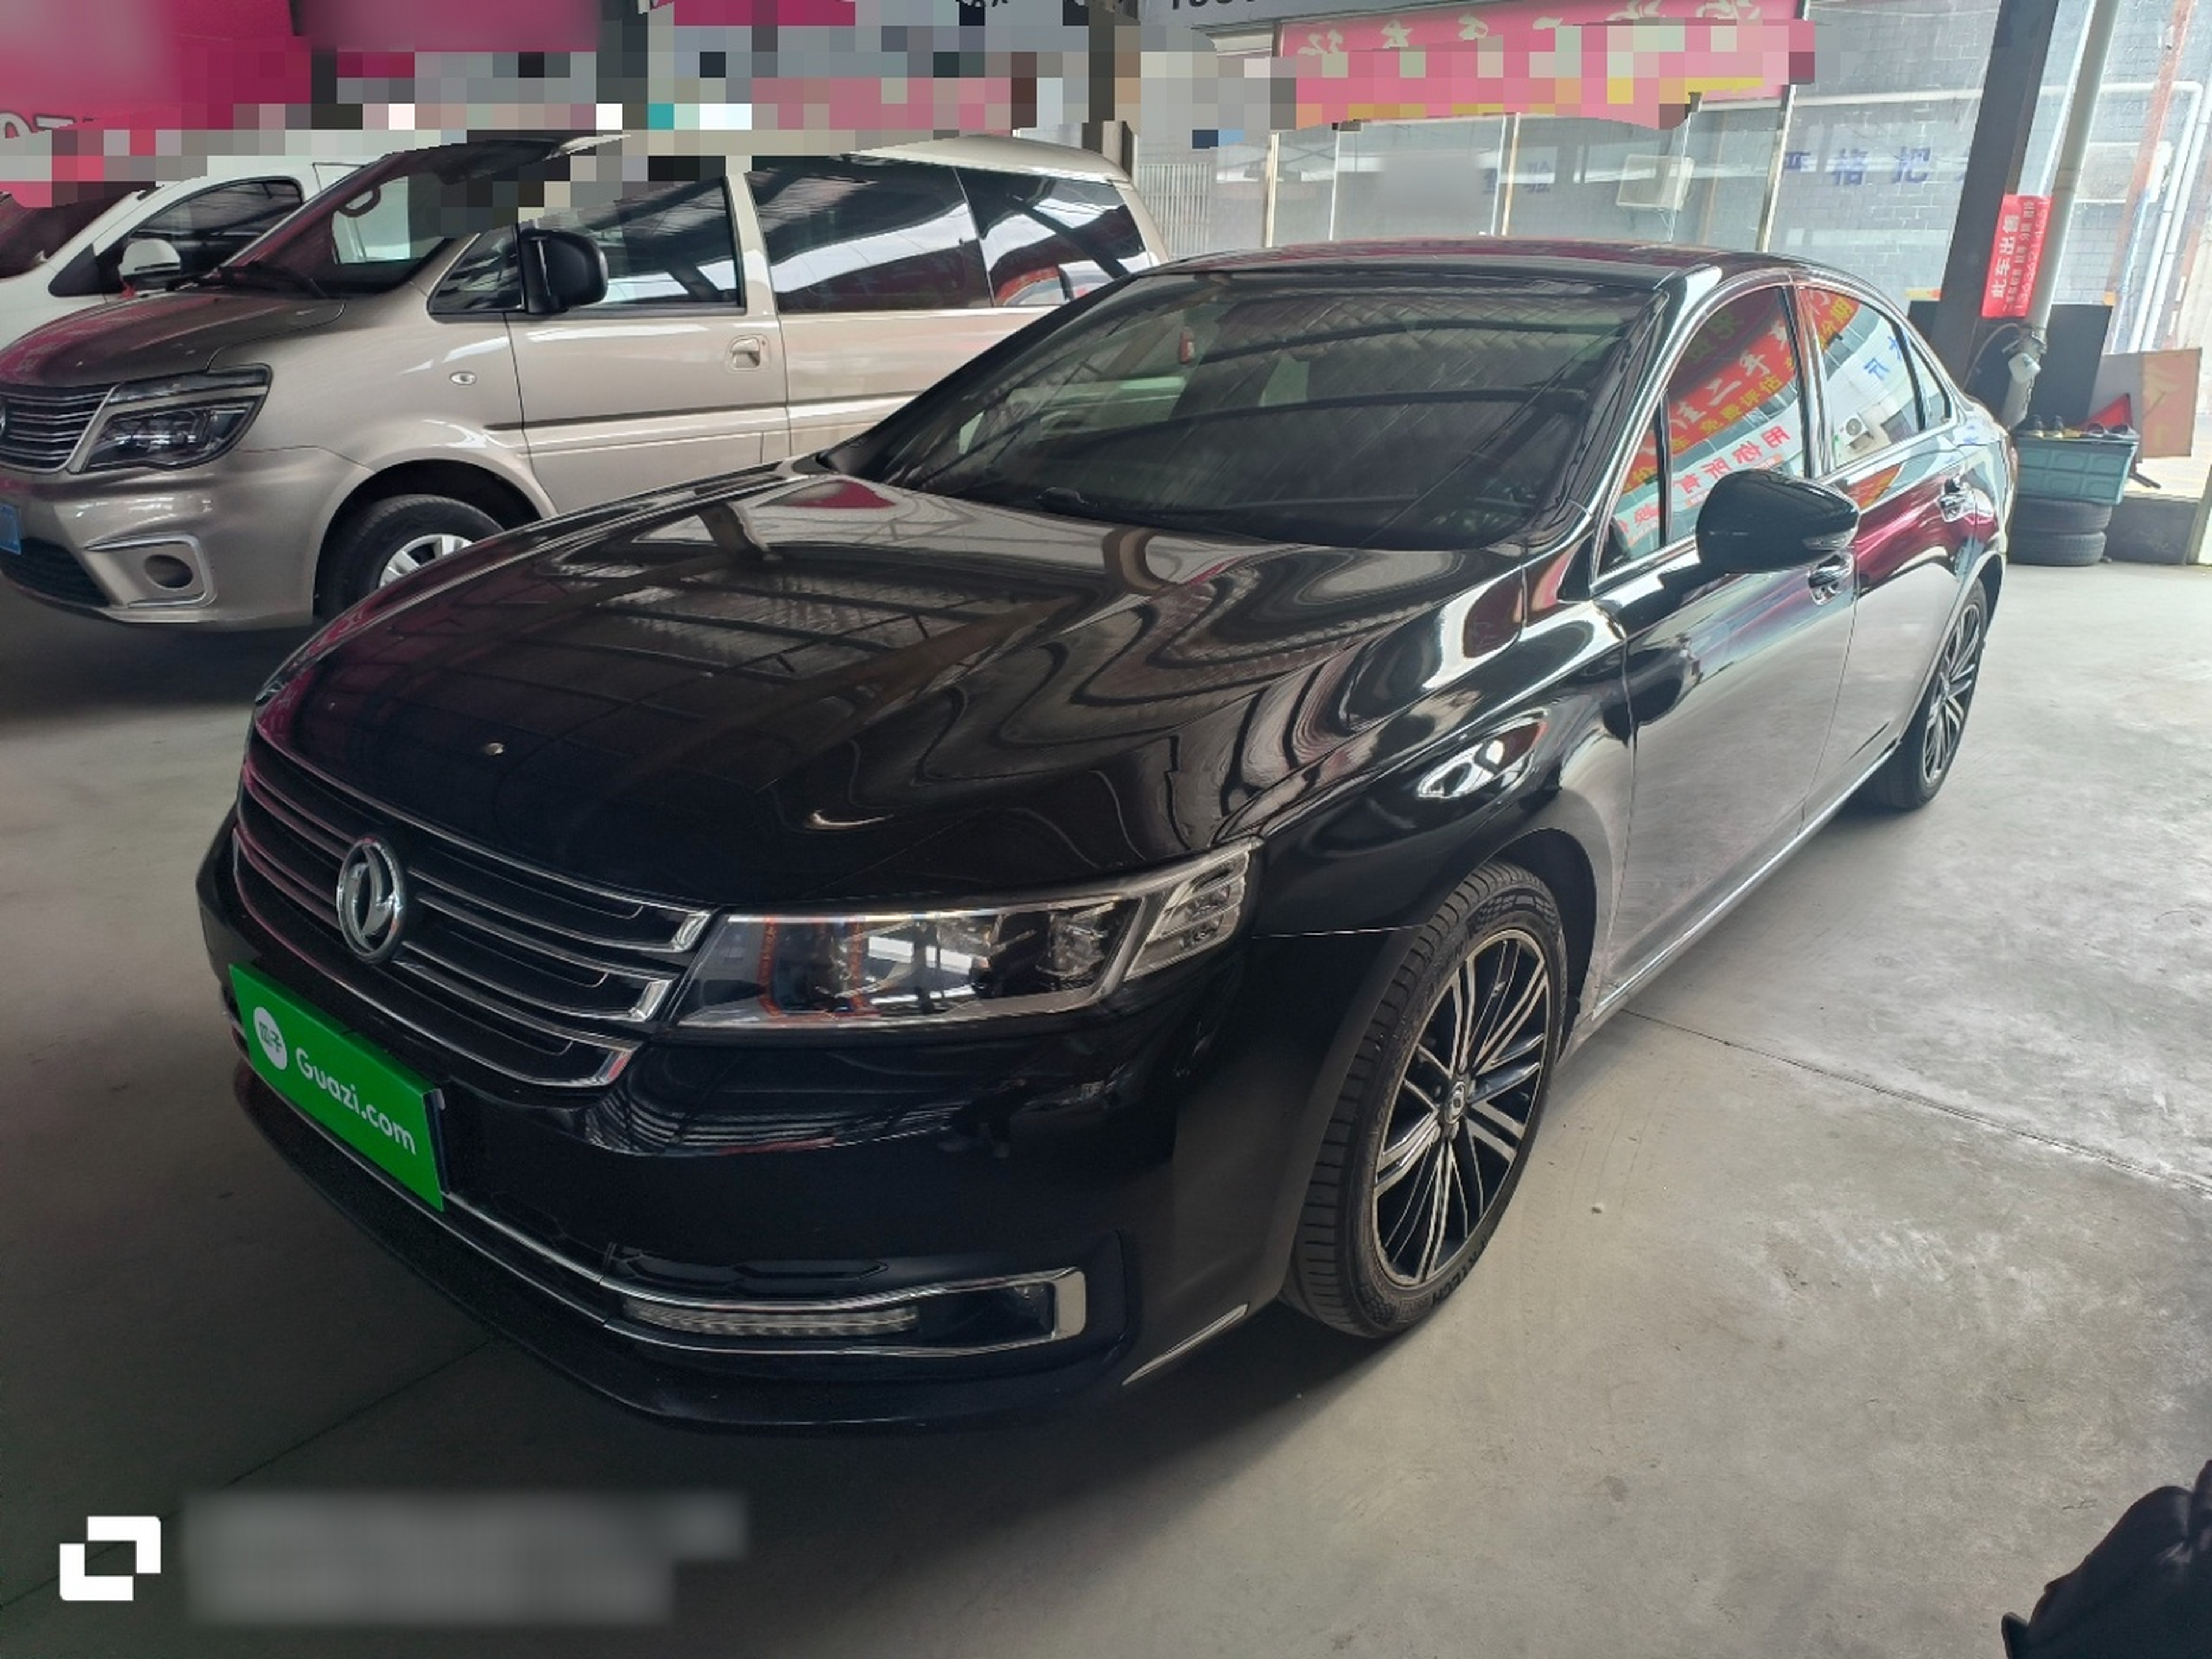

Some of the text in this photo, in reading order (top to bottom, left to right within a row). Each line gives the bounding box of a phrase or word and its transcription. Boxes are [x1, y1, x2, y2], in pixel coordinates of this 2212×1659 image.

[1700, 374, 1782, 434] 免费评估
[295, 1047, 417, 1156] Guazi.com
